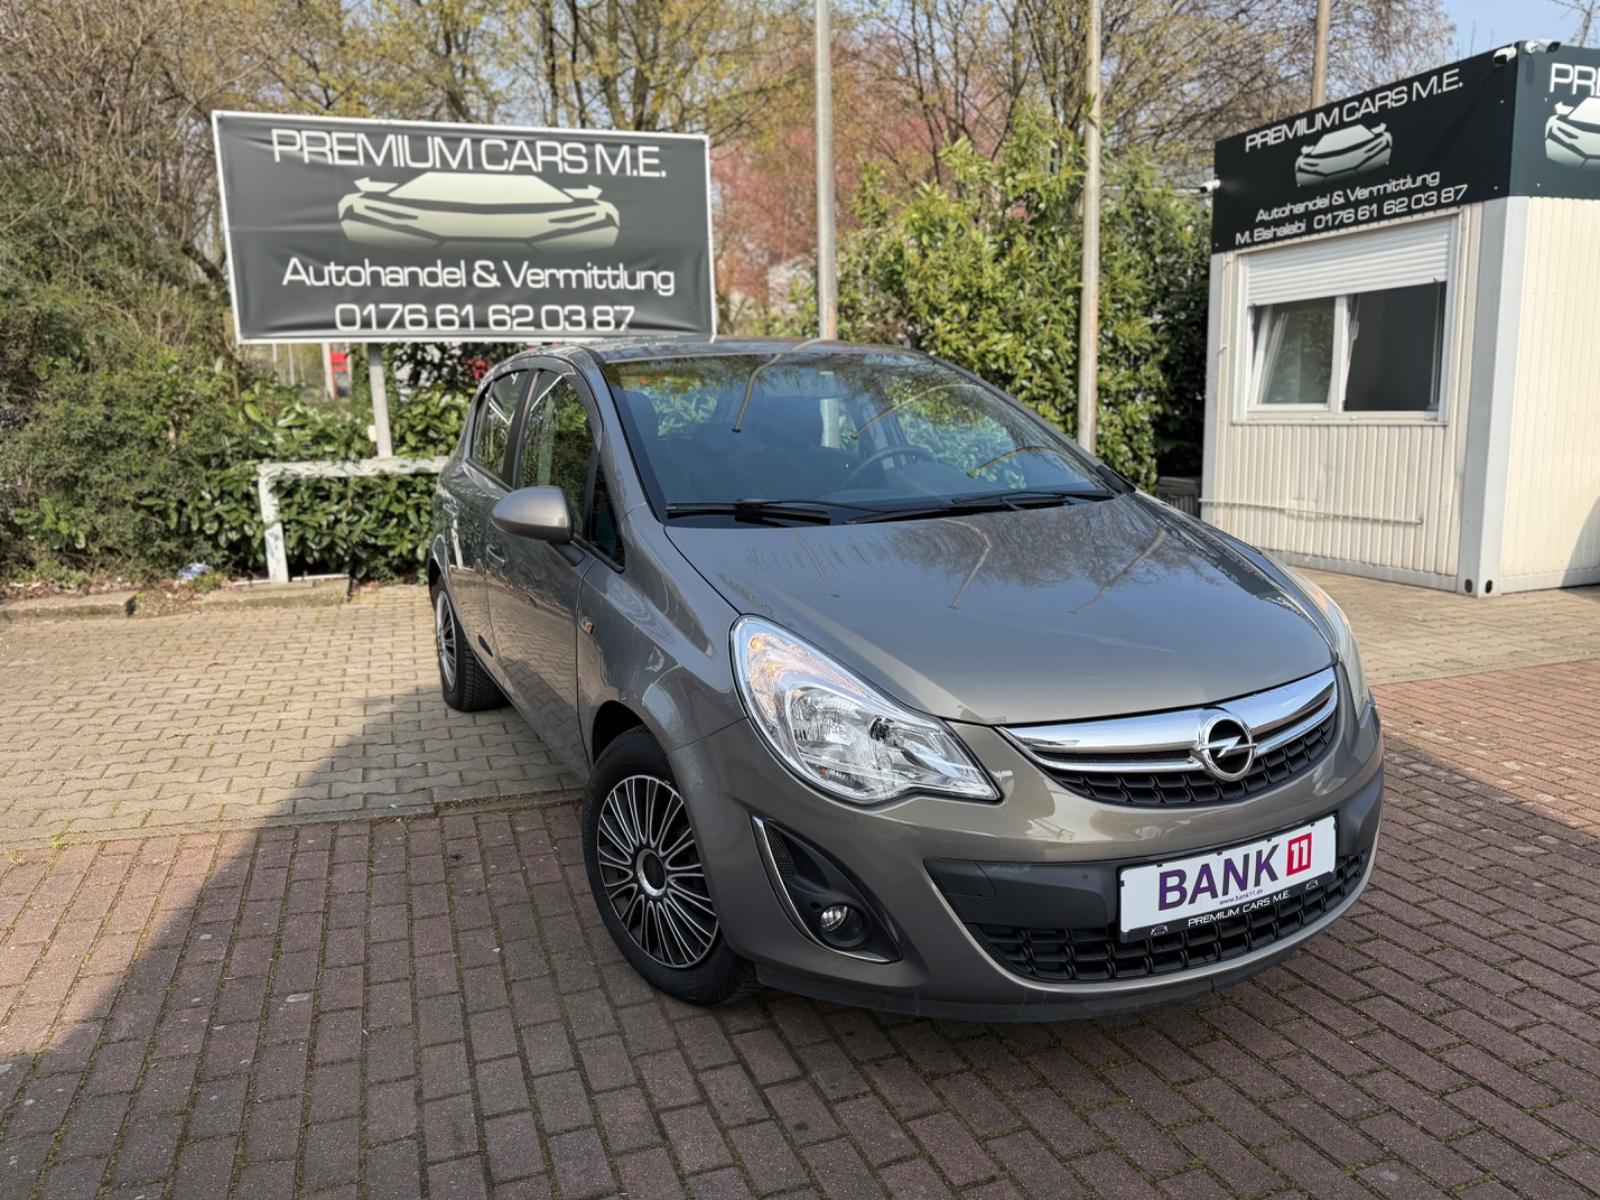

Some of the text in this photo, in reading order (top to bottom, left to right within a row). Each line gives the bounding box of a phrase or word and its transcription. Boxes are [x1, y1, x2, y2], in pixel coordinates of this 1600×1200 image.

[1549, 63, 1600, 97] PR
[1245, 68, 1463, 152] PREMIUM CARS M.E.
[271, 128, 667, 178] PREMIUM CARS M.E.
[1235, 231, 1251, 245] M.
[1313, 207, 1355, 230] 0176
[1357, 204, 1378, 221] 61
[1383, 198, 1409, 215] 62
[1411, 191, 1437, 209] 03
[1441, 184, 1468, 203] 87
[1255, 171, 1440, 222] Autohandel & Vermittlung
[282, 257, 676, 297] Autohandel & Vermittlung
[334, 303, 635, 332] 0176 61 62 03 87
[1158, 837, 1310, 912] BANK 11
[1187, 907, 1240, 928] PREMIUM
[1242, 897, 1271, 913] CARS
